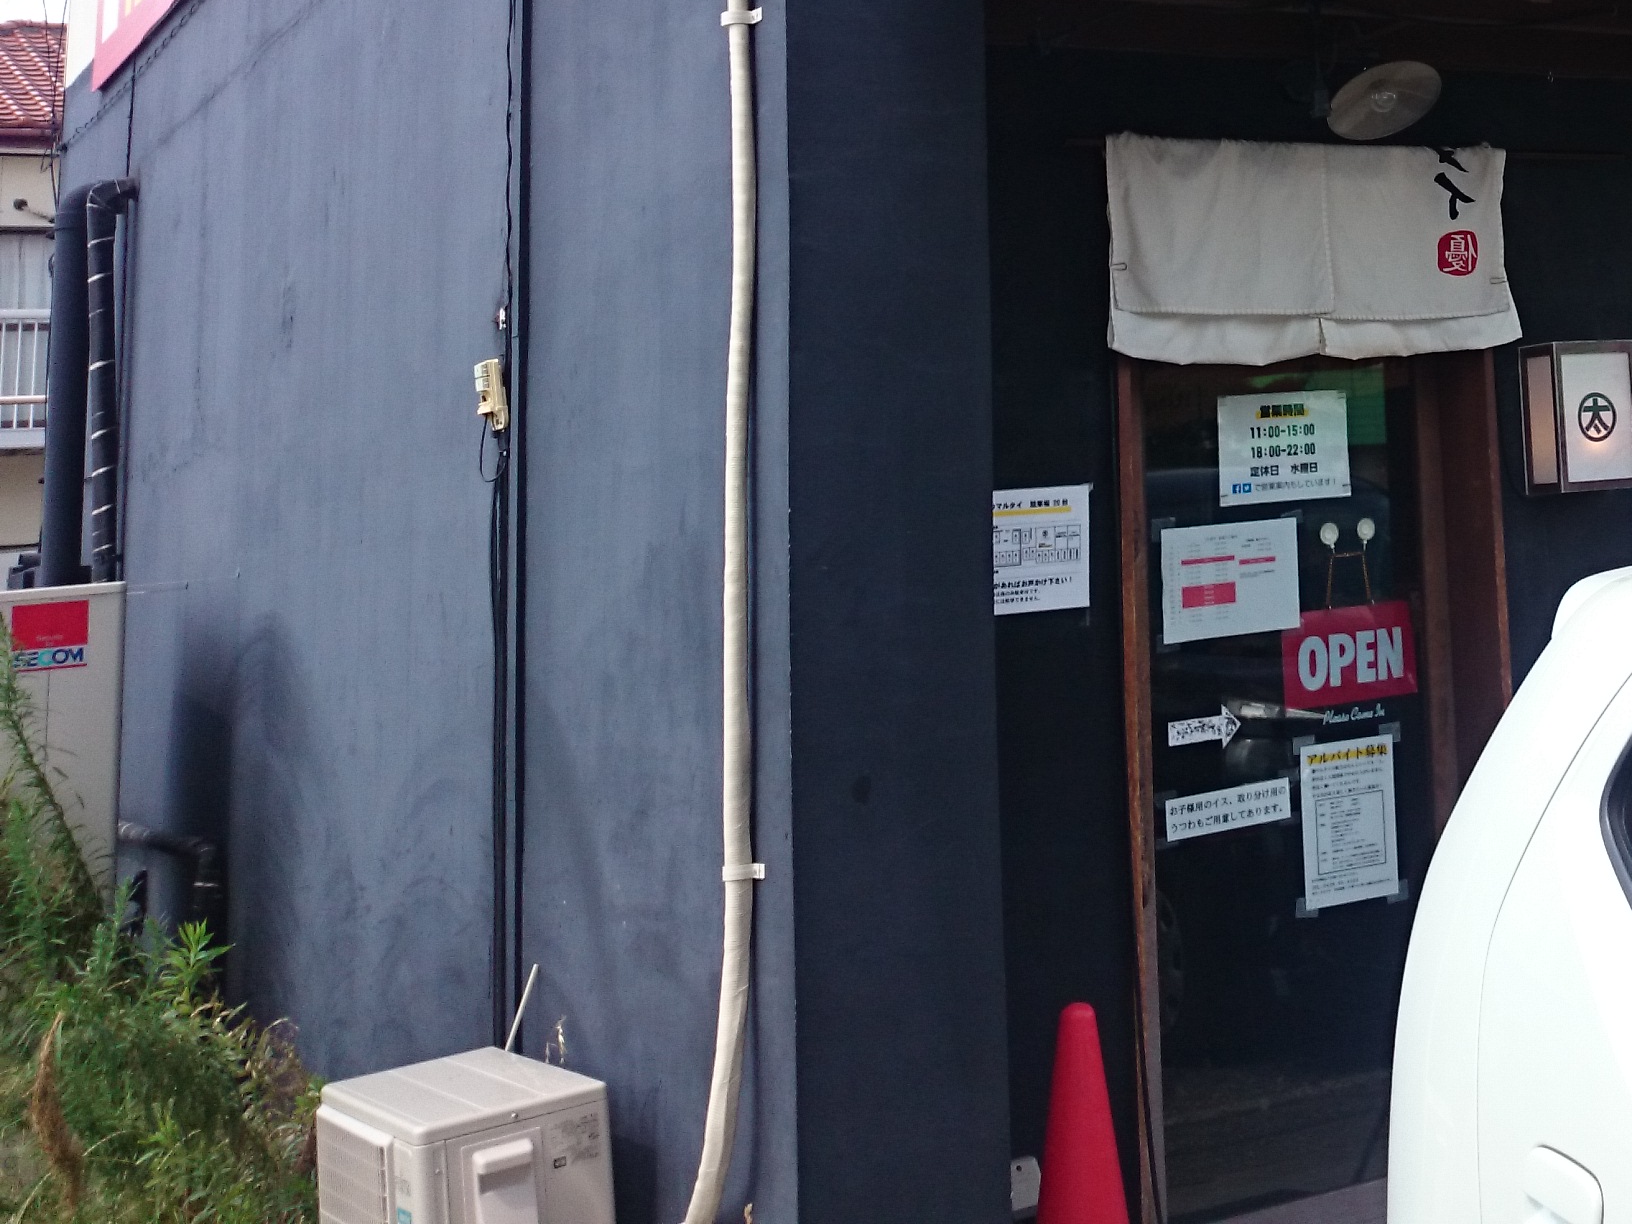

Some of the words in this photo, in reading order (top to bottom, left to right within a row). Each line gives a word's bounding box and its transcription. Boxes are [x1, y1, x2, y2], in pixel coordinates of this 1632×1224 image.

[1259, 403, 1305, 419] 営業時間
[1250, 423, 1316, 440] 11:00-15:00
[1251, 443, 1317, 460] 18:00-22:00
[1250, 464, 1280, 478] 定休日
[1290, 461, 1319, 475] 水曜日
[13, 648, 84, 668] SECOM
[1298, 627, 1404, 691] OPEN
[1322, 709, 1350, 725] Please
[1350, 707, 1374, 721] Come
[1375, 703, 1385, 717] In
[1171, 804, 1284, 834] うつわもご用意してあります。
